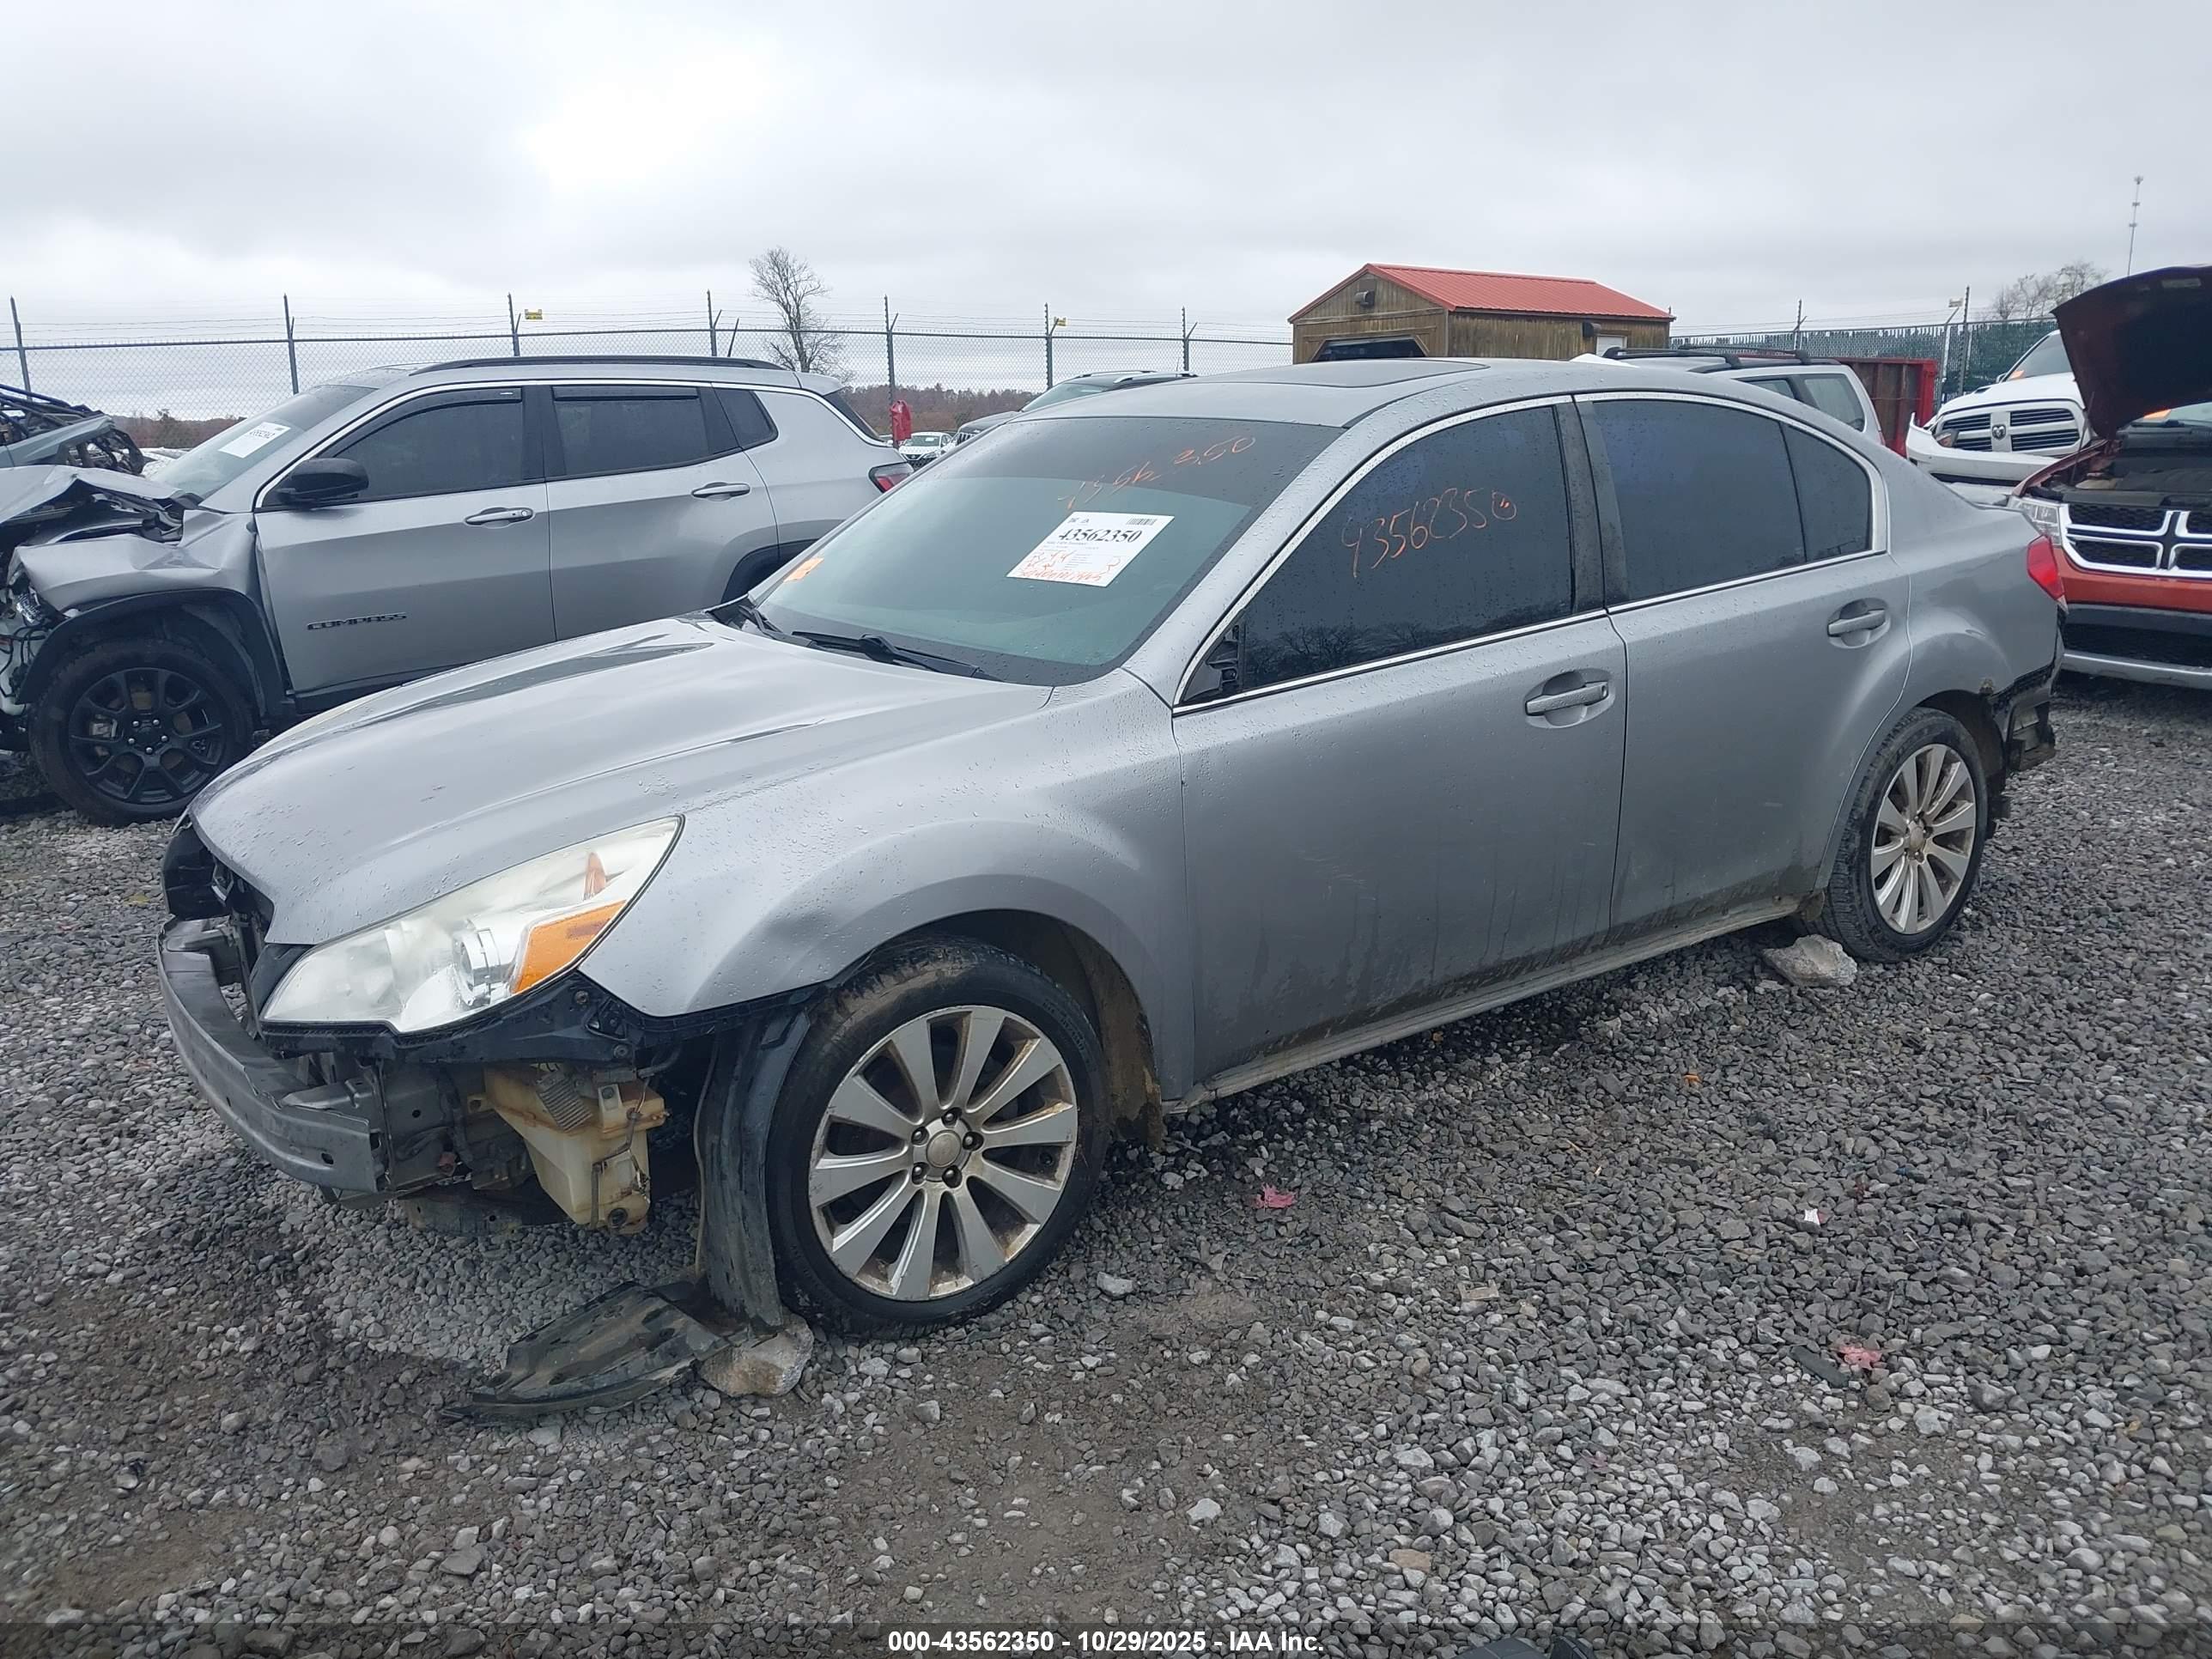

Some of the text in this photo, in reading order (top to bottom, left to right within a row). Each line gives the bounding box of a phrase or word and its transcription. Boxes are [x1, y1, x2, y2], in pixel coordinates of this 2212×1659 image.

[1058, 528, 1143, 544] 43562350
[1340, 487, 1517, 579] 43562350
[307, 611, 408, 630] COMPASS
